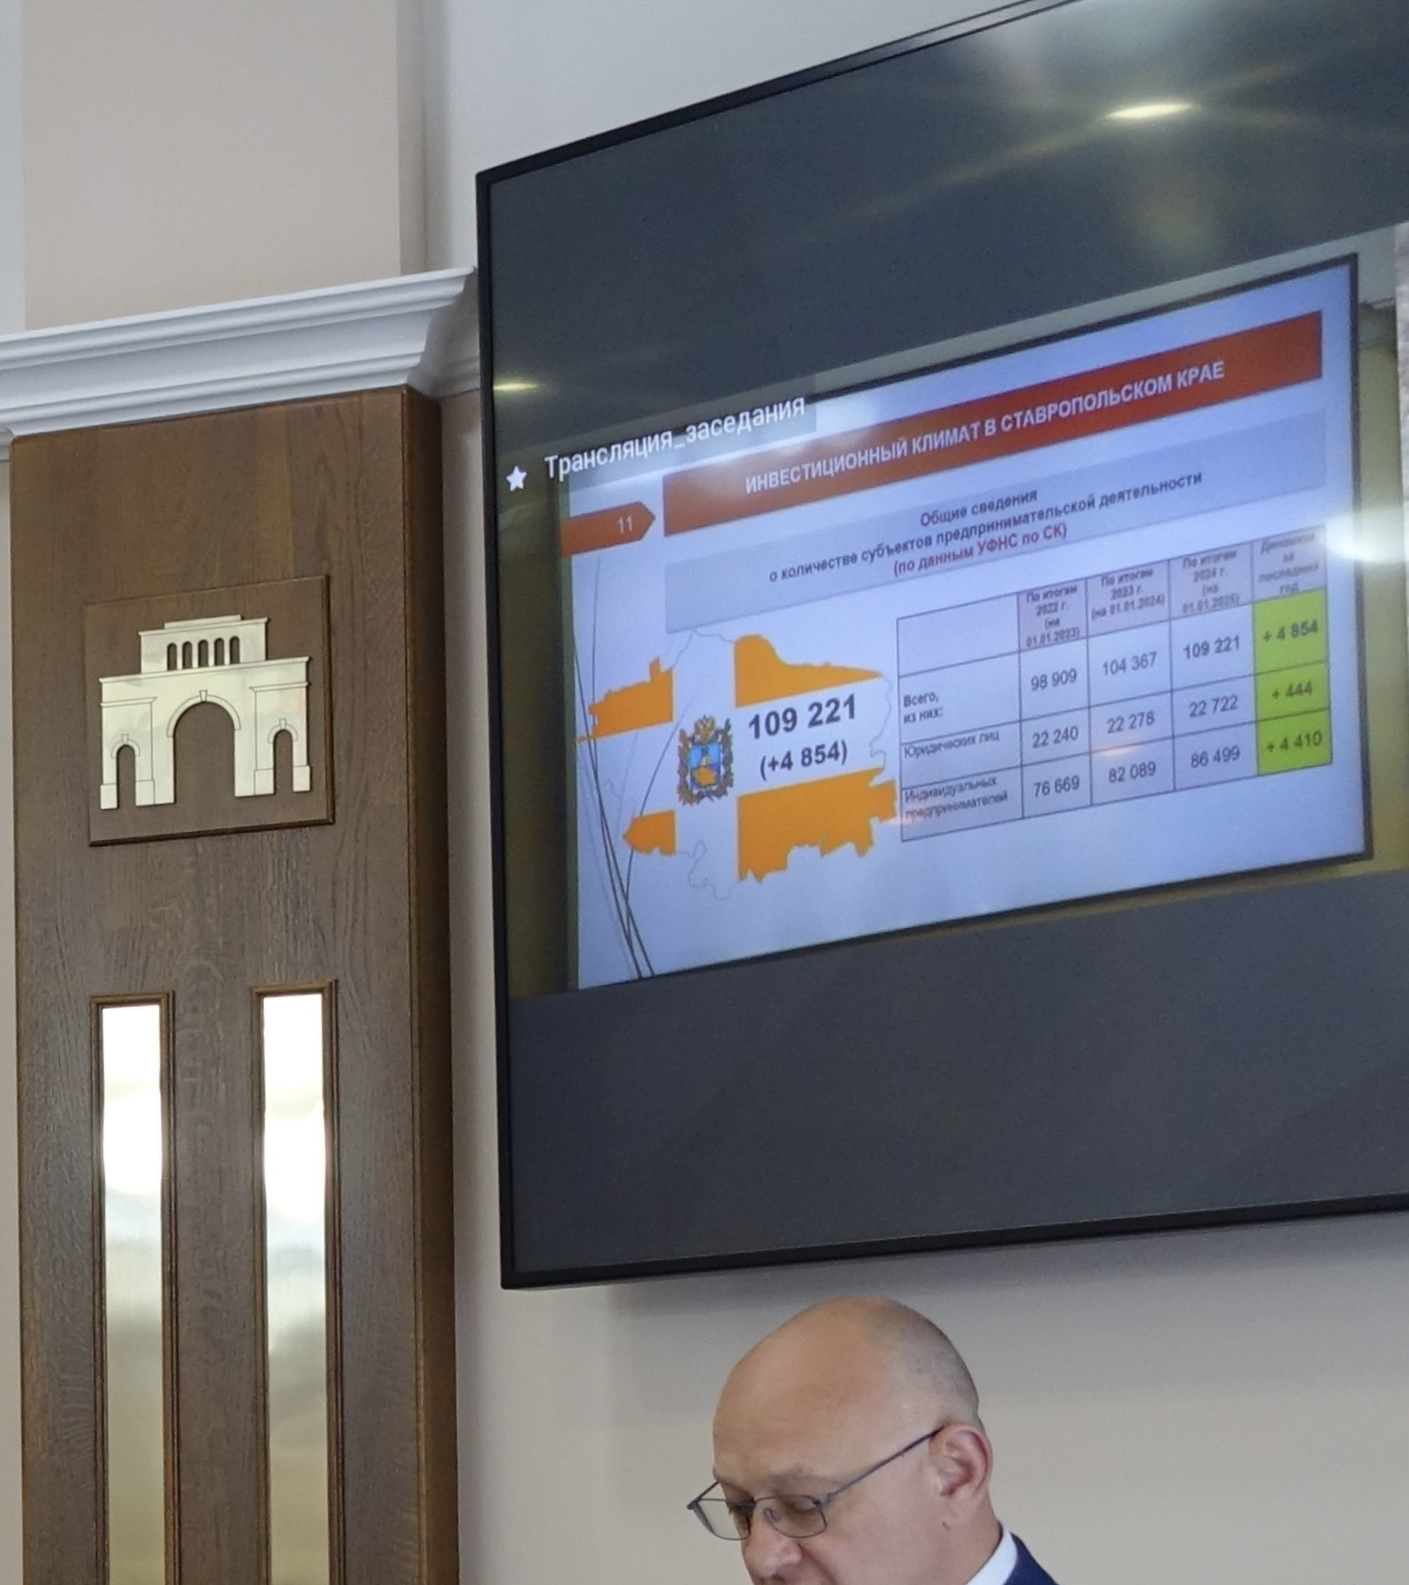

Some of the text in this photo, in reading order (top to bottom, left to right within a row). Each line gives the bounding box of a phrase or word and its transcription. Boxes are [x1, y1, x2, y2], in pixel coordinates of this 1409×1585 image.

[544, 397, 806, 482] Трансляция_заседания
[745, 361, 1225, 494] ИНВЕСТИЦИОННЫЙ КЛИМАТ В СТАВРОПОЛЬСКОМ КРАЕ
[920, 489, 1038, 527] Общие сведения
[617, 515, 633, 534] 11
[769, 472, 1202, 583] о количестве субъектов предпринимательской деятельности
[893, 521, 1068, 578] (по данным УФНС по СК)
[1276, 625, 1286, 641] 4
[1291, 619, 1318, 639] 854
[1183, 635, 1240, 660] 109 221
[1102, 651, 1157, 677] 104 367
[1031, 668, 1078, 691] 98 909
[1285, 680, 1313, 698] 444
[903, 691, 940, 708] Всего,
[1189, 694, 1238, 718] 22 722
[748, 693, 856, 740] 109 221
[1106, 710, 1155, 735] 22 278
[1032, 725, 1079, 749] 22 240
[1279, 736, 1290, 752] 4
[1293, 730, 1323, 749] 410
[759, 739, 848, 781] (+4 854)
[1190, 745, 1241, 769] 86 499
[1108, 761, 1157, 784] 82 089
[905, 776, 997, 803] Индивидуальных
[1033, 775, 1080, 798] 76 669
[905, 791, 1008, 823] предпринимателей
